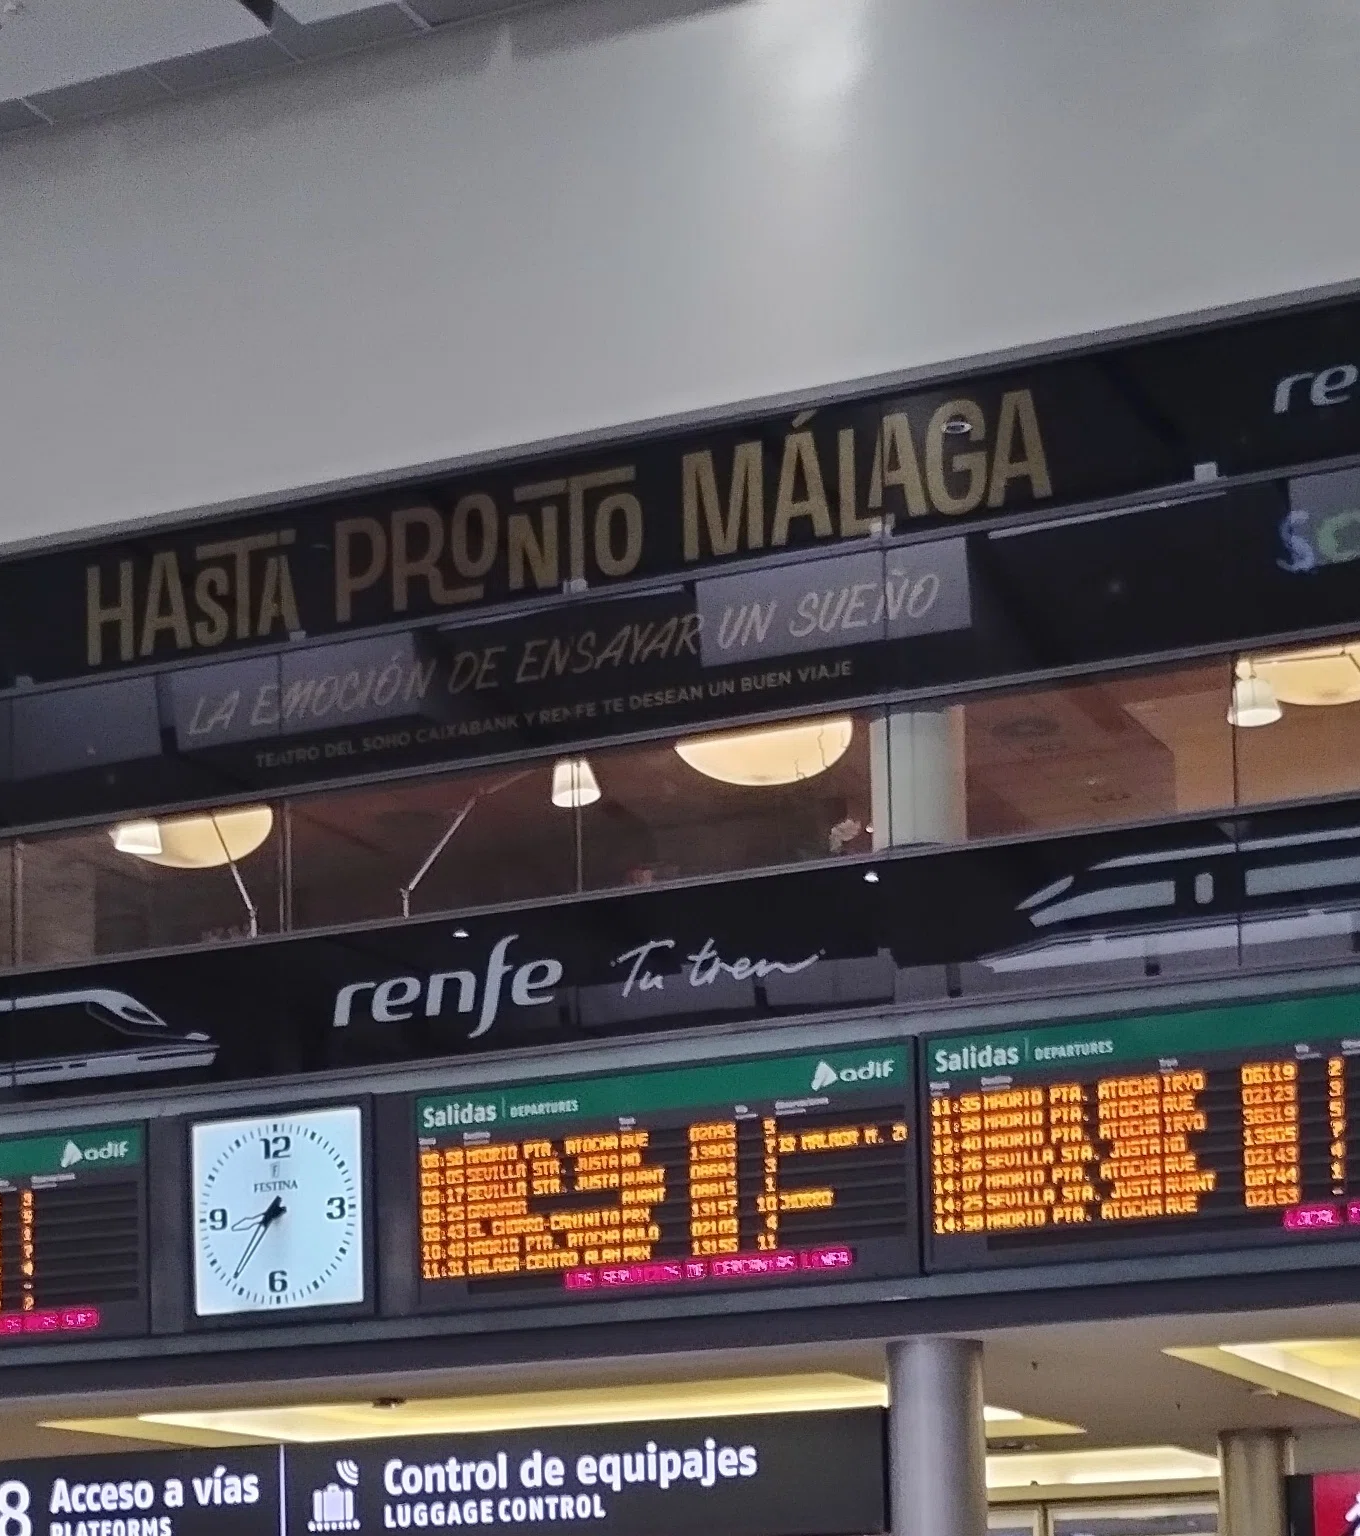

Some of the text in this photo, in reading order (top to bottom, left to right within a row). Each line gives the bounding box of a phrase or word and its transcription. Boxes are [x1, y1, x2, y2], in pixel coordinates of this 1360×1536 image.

[85, 388, 1052, 667] HASTA PRONTO MÁLAGA
[188, 571, 942, 736] LA EMOCIÓN DE ENSAYAR UN SUEÑO
[256, 748, 319, 769] TEATRO
[324, 740, 357, 759] DEL
[363, 733, 410, 754] SOHO
[417, 715, 517, 744] CAIXABANK
[524, 713, 534, 727] Y
[602, 697, 624, 715] TE
[629, 686, 703, 712] DESEAN
[709, 679, 735, 698] UN
[741, 672, 792, 693] BUEN
[798, 660, 852, 684] VIAJE
[616, 937, 821, 998] Tu tren
[332, 935, 563, 1039] renfe
[840, 1059, 895, 1082] adif
[935, 1040, 1113, 1073] Salidas DEPARTURES
[932, 1094, 981, 1116] 11:35
[984, 1089, 1043, 1110] MADRID
[1098, 1076, 1159, 1100] ATOCHA
[1163, 1072, 1204, 1092] IRYO
[932, 1114, 981, 1136] 11:58
[984, 1109, 1043, 1129] MADRID
[1099, 1098, 1159, 1119] ATOCHA
[1163, 1095, 1195, 1112] AVE
[1242, 1085, 1297, 1105] 02123
[423, 1100, 579, 1128] Salidas DEPARTURES
[84, 1141, 128, 1160] adif
[260, 1136, 291, 1159] 12
[932, 1135, 982, 1156] 12:40
[984, 1129, 1044, 1149] MADRID
[1099, 1118, 1160, 1139] ATOCHA
[1164, 1114, 1205, 1132] IRYO
[933, 1155, 982, 1175] 13:26
[985, 1148, 1053, 1170] SEVILLA
[1110, 1139, 1161, 1159] JUSTA
[934, 1175, 982, 1195] 14:07
[986, 1169, 1044, 1189] MADRID
[1100, 1159, 1161, 1180] ATOCHA
[1165, 1155, 1196, 1173] AVE
[253, 1180, 298, 1193] FESTINA
[467, 1182, 527, 1201] SEVILLA
[575, 1173, 619, 1191] JUSTA
[934, 1195, 983, 1215] 14:25
[986, 1188, 1054, 1208] SEVILLA
[1111, 1179, 1161, 1199] JUSTA
[1165, 1174, 1215, 1193] AVANT
[209, 1197, 346, 1231] 9 3
[987, 1209, 1045, 1228] MADRID
[1102, 1198, 1162, 1220] ATOCHA
[1166, 1196, 1198, 1214] AVE
[268, 1270, 288, 1293] 6
[384, 1438, 758, 1495] Control de equipajes
[50, 1465, 260, 1513] Acceso a vías
[384, 1494, 606, 1528] LUGGAGE CONTROL
